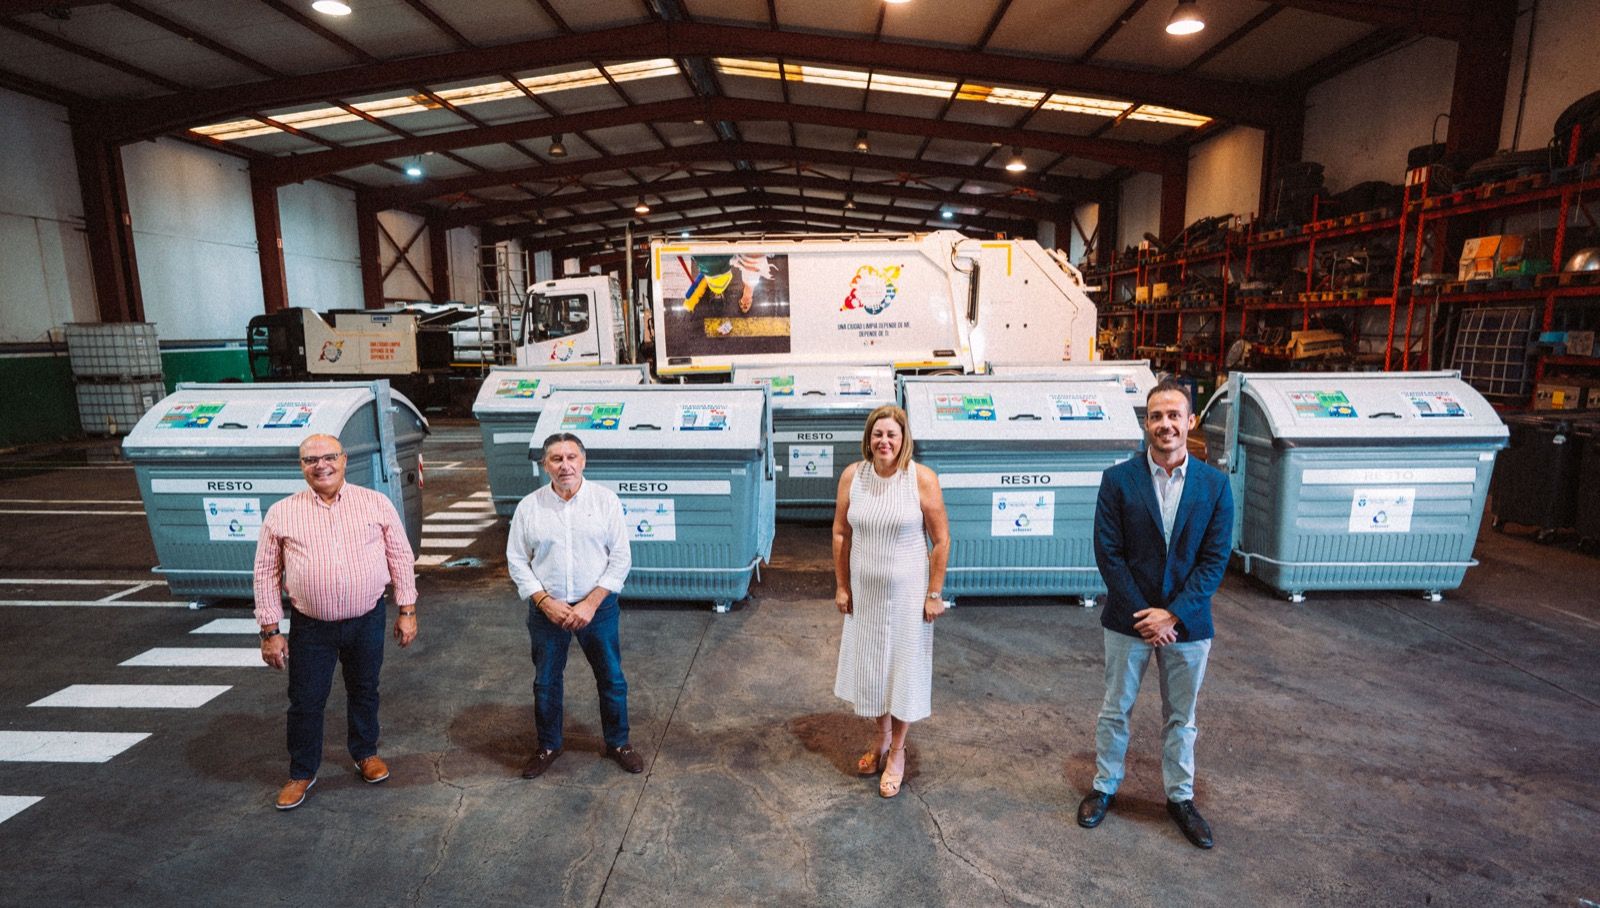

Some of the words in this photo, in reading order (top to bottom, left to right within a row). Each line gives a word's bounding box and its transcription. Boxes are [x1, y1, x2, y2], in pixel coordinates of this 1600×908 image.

[798, 432, 834, 440] RESTO
[1000, 474, 1051, 485] RESTO
[1364, 470, 1414, 480] RESTO
[208, 481, 252, 491] RESTO
[618, 482, 668, 492] RESTO
